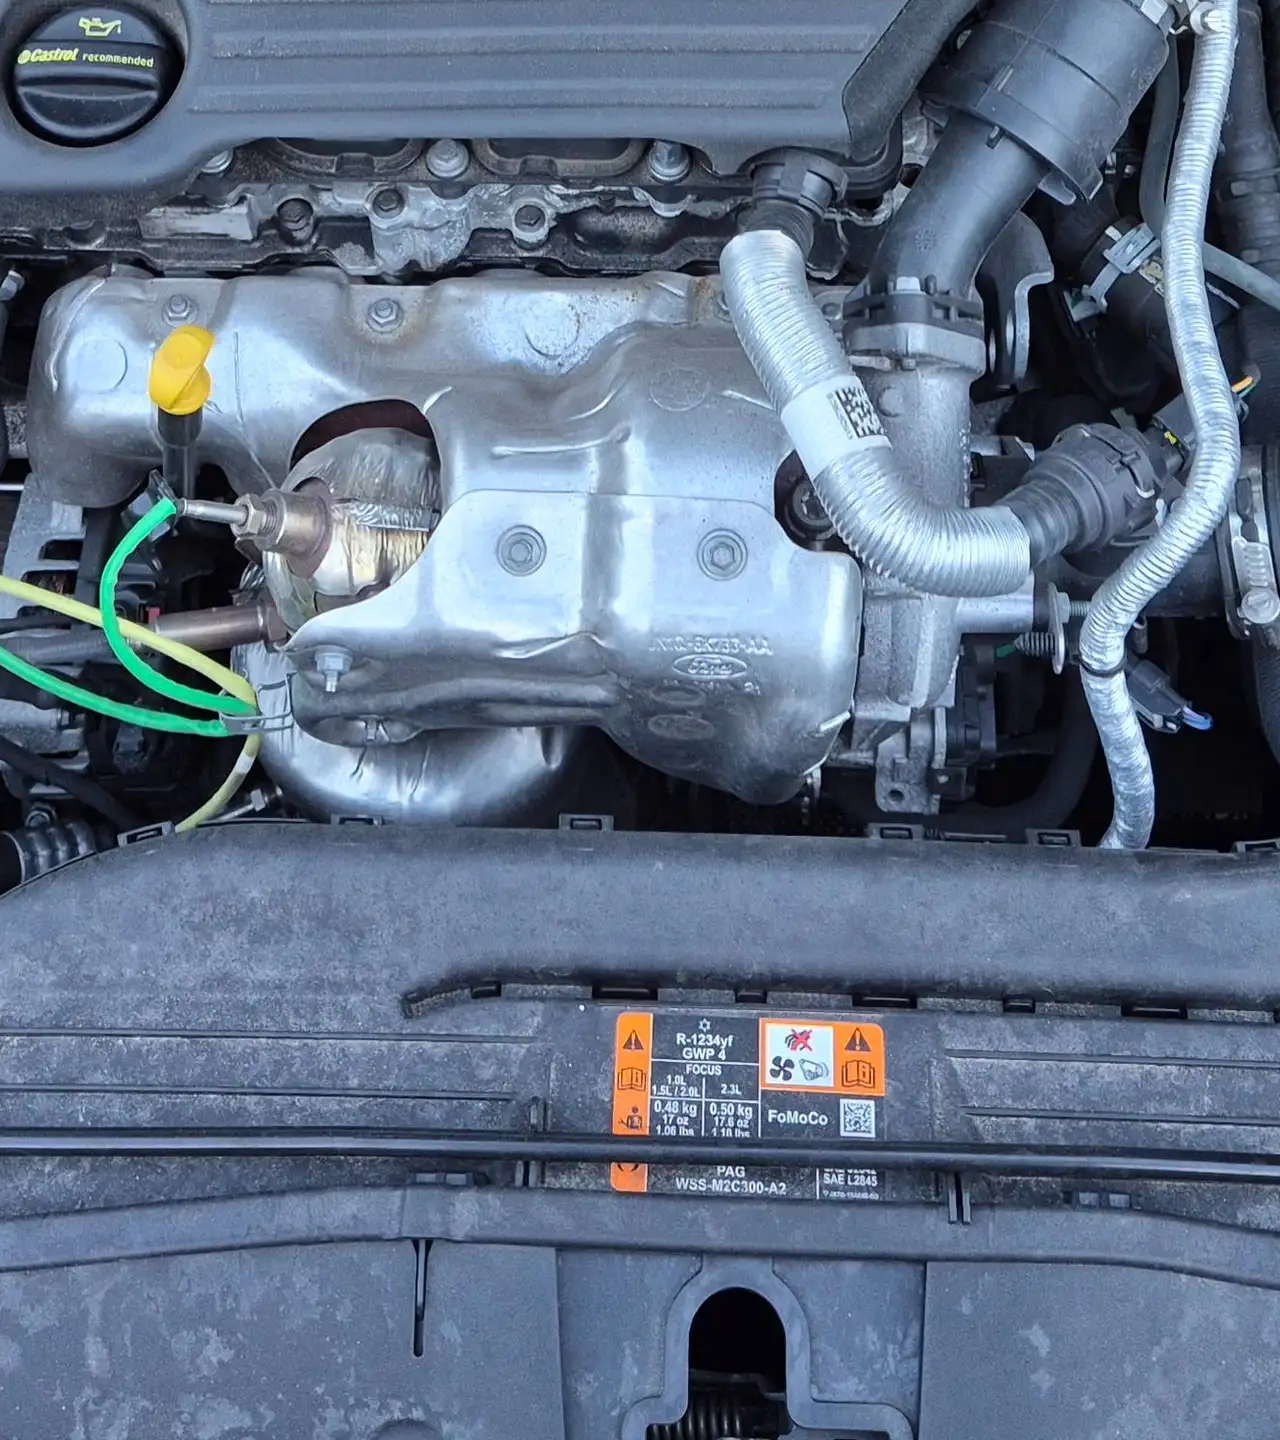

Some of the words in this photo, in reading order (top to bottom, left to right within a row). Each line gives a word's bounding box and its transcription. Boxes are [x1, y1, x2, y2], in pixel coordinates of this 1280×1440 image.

[31, 47, 80, 63] Castrol
[82, 52, 154, 68] recommended
[676, 1032, 734, 1049] R-1234yf
[682, 1047, 715, 1060] GWP
[717, 1047, 726, 1061] 4
[685, 1063, 722, 1076] FOCUS
[666, 1074, 687, 1086] 1.0L
[651, 1084, 672, 1097] 1.5L
[680, 1086, 701, 1098] 2.0L
[720, 1083, 742, 1096] 2.3L
[654, 1099, 679, 1114] 0.48
[681, 1101, 698, 1118] kg
[709, 1101, 734, 1117] 0.50
[737, 1103, 753, 1120] kg
[662, 1113, 674, 1125] 17
[676, 1116, 690, 1126] oz
[713, 1116, 735, 1128] 17.6
[736, 1119, 750, 1129] oz
[767, 1109, 829, 1126] FoMoCo
[656, 1124, 677, 1137] 1.06
[716, 1165, 746, 1179] PAG
[675, 1177, 787, 1196] WSS-M2C300-A2
[823, 1172, 845, 1185] SAE
[847, 1174, 878, 1187] L2845
